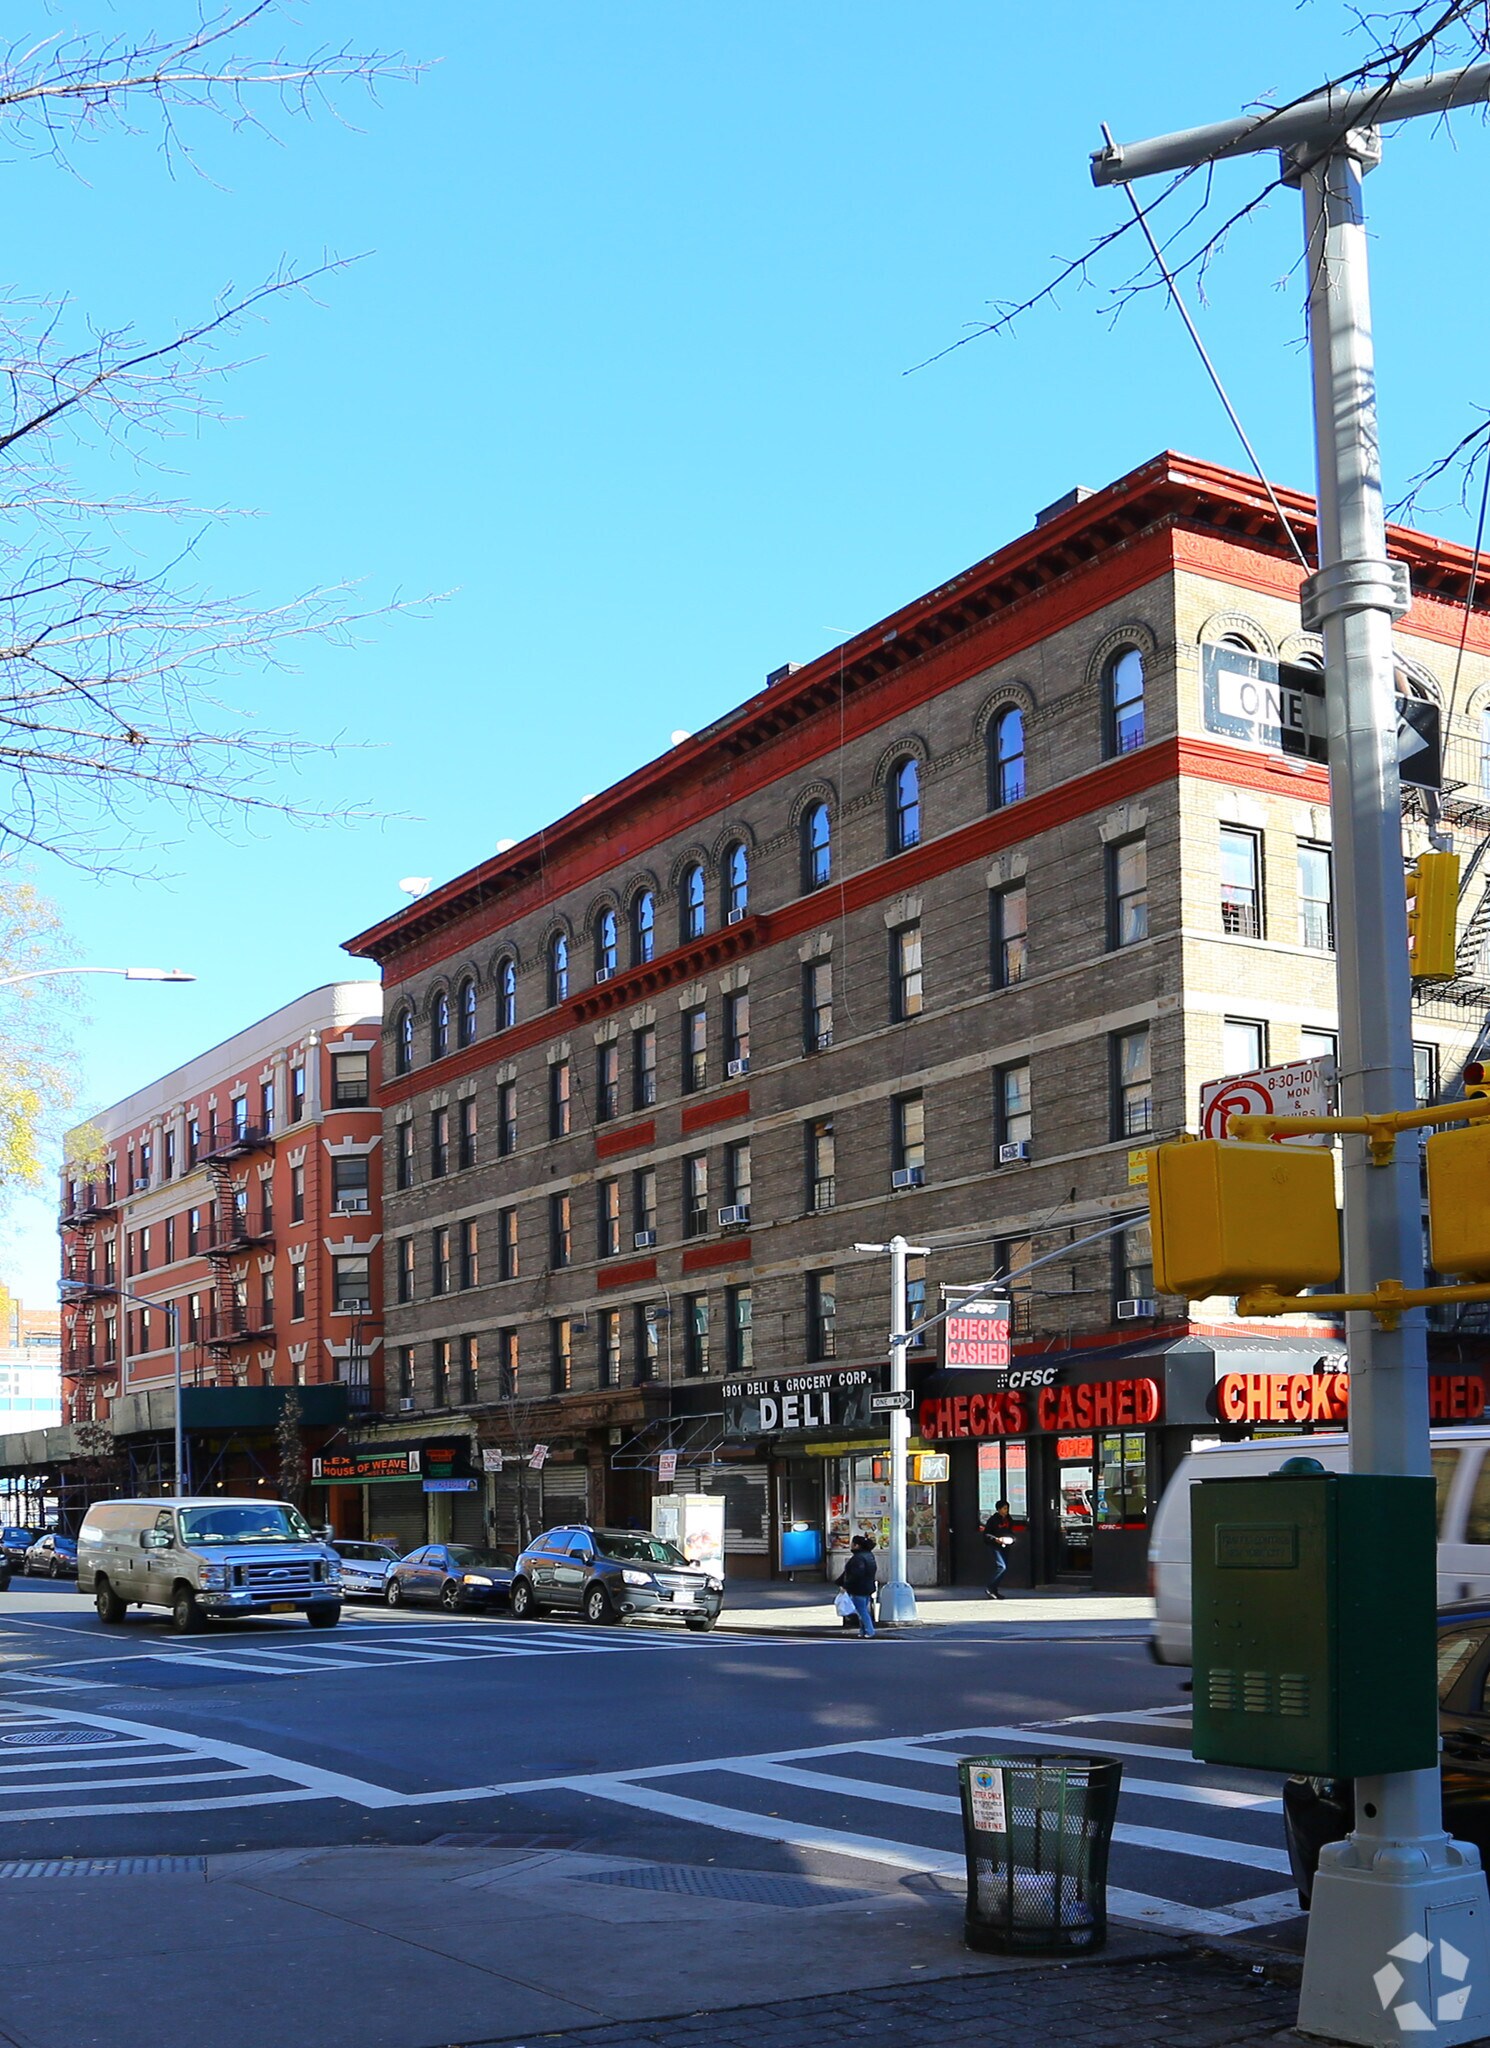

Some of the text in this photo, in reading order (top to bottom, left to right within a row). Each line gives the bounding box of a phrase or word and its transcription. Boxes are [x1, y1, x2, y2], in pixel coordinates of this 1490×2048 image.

[1240, 682, 1303, 729] ONE
[1287, 1086, 1311, 1099] MON
[1294, 1100, 1302, 1110] &
[948, 1317, 1009, 1342] CHECKS
[948, 1341, 1009, 1365] CASHED
[721, 1370, 872, 1398] 1901 DELI & GROCERY CORP.
[1008, 1368, 1055, 1389] CFSC
[875, 1397, 888, 1407] ONE
[920, 1377, 1161, 1440] CHECKS CASHED
[1222, 1372, 1348, 1421] CHECKS
[759, 1391, 831, 1430] DELI
[323, 1456, 351, 1465] LEX
[323, 1459, 408, 1477] HOUSE OF WEAVE
